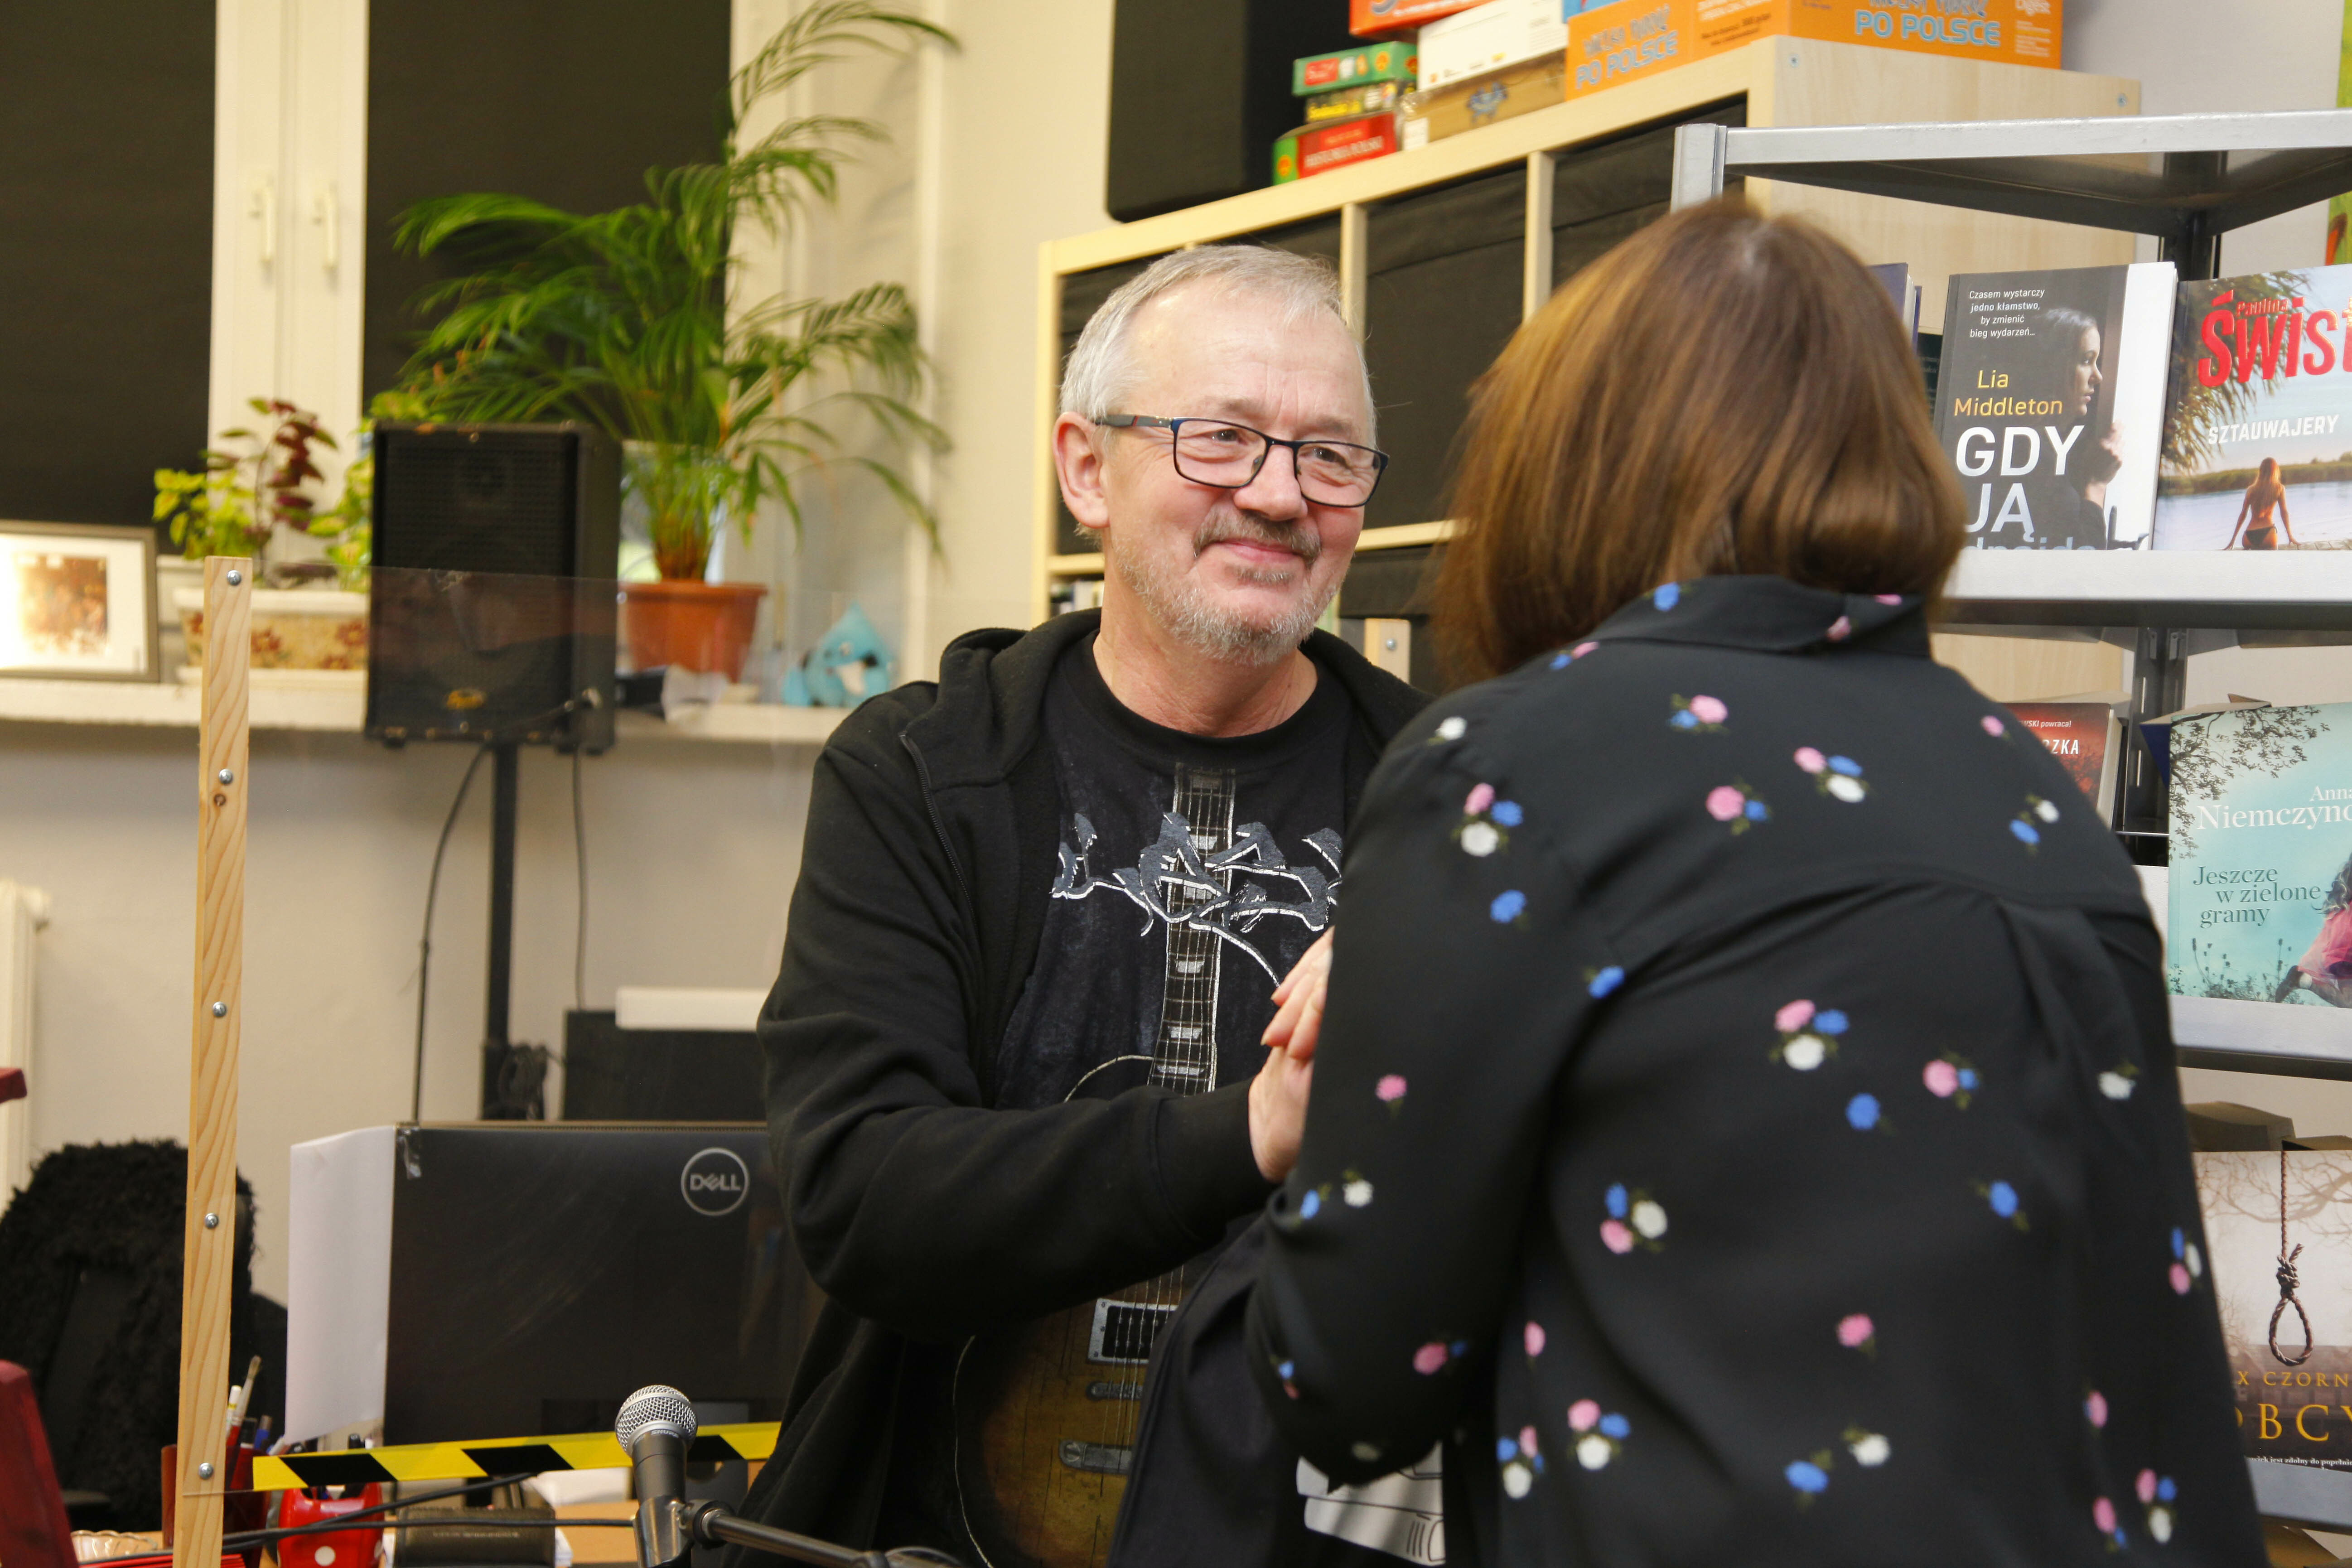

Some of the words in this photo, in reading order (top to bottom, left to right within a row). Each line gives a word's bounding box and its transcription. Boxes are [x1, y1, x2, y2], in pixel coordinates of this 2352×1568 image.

[1855, 9, 1893, 38] PO
[1901, 13, 2000, 47] POLSCE
[1575, 59, 1602, 89] PO
[1607, 30, 1678, 79] POLSCE
[1970, 289, 2001, 299] Czasem
[2004, 289, 2045, 299] wystarczy
[1970, 303, 1994, 313] jedno
[1997, 302, 2040, 312] kłamstwo,
[2236, 297, 2289, 317] Paulina
[1980, 316, 1990, 325] by
[1993, 314, 2025, 323] zmienić
[1970, 328, 1988, 338] bieg
[1977, 370, 2009, 388] Lia
[1954, 397, 2063, 416] Middleton
[2208, 414, 2339, 444] SZTAUWAJERY
[1956, 425, 2085, 477] GDY
[2041, 720, 2072, 728] powraca!
[2193, 865, 2279, 886] Jeszcze
[2216, 890, 2234, 903] w
[2240, 882, 2321, 902] zielone
[2200, 907, 2270, 929] gramy
[690, 1173, 741, 1191] DELL
[2285, 1457, 2309, 1465] zdolny
